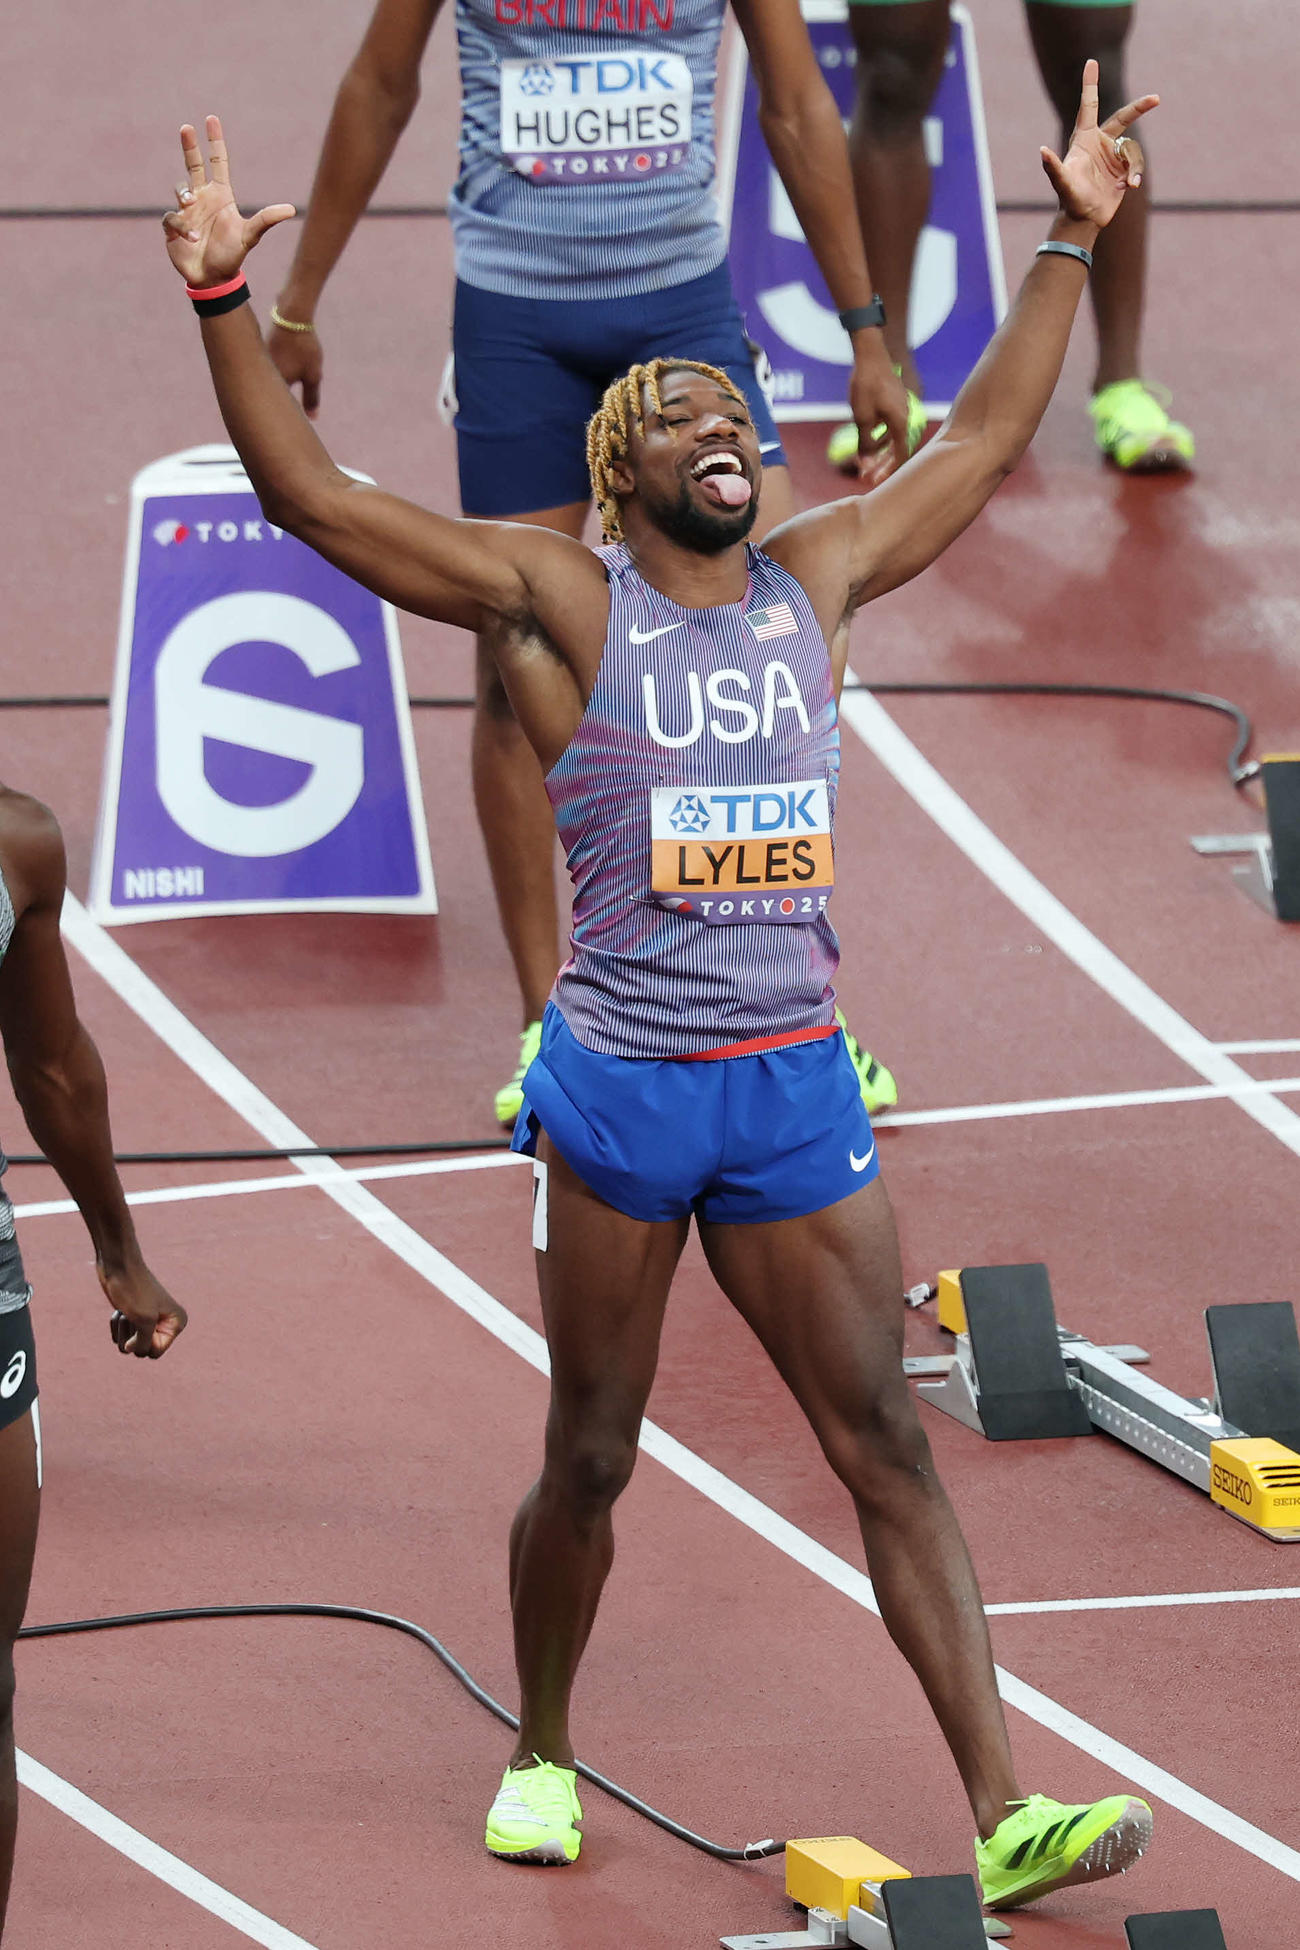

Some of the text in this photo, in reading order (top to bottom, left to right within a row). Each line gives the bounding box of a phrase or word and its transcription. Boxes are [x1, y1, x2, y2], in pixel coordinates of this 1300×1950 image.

[555, 57, 675, 94] TDK
[515, 103, 680, 146] HUGHES
[154, 590, 365, 858] 6
[642, 660, 811, 749] USA
[709, 788, 818, 833] TDK
[123, 867, 205, 899] NISHI
[677, 839, 816, 886] LYLES
[1213, 1463, 1253, 1506] SEIKO
